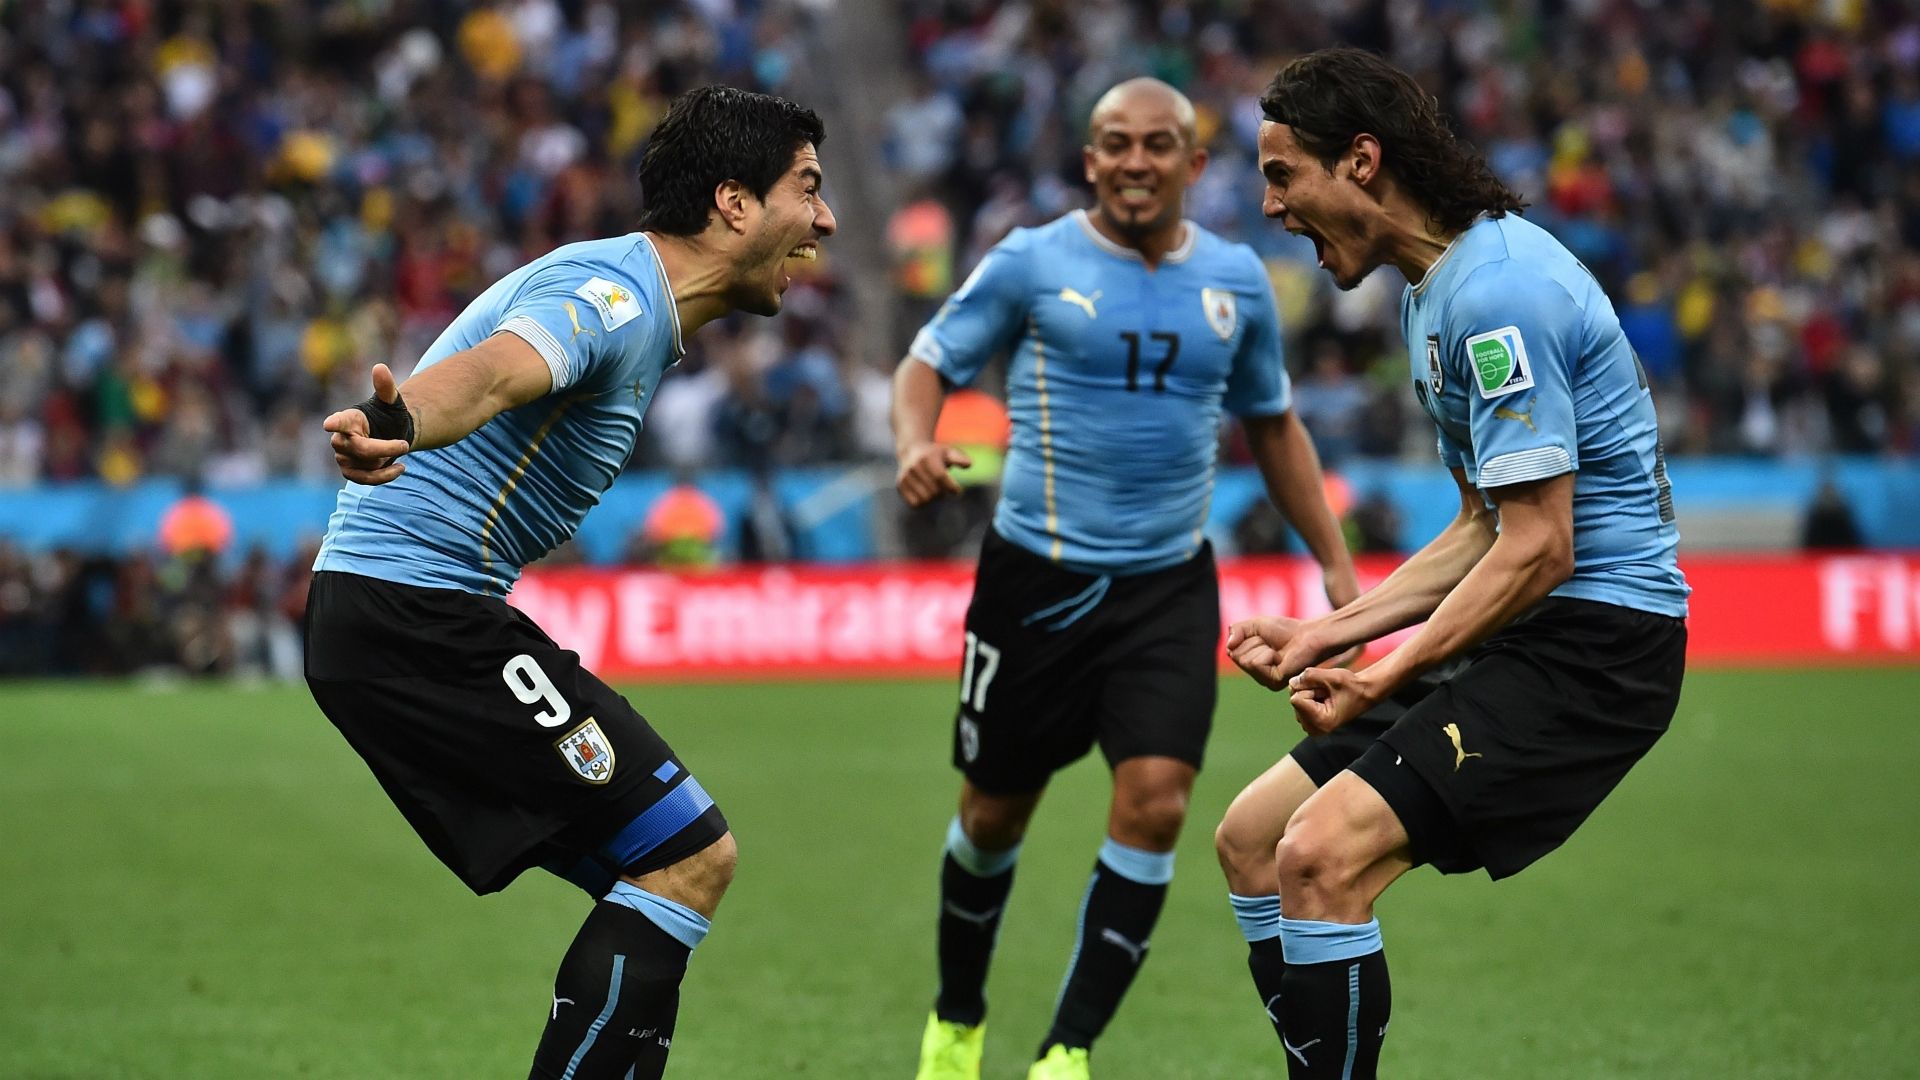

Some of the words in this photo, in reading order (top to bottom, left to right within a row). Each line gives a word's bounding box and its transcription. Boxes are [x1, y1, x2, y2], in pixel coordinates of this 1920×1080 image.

[1119, 331, 1179, 392] 17
[1475, 347, 1505, 359] FOOTBALL
[1488, 352, 1504, 361] HOPE
[616, 565, 972, 663] Emirate
[502, 654, 572, 728] 9
[961, 630, 1001, 713] 17
